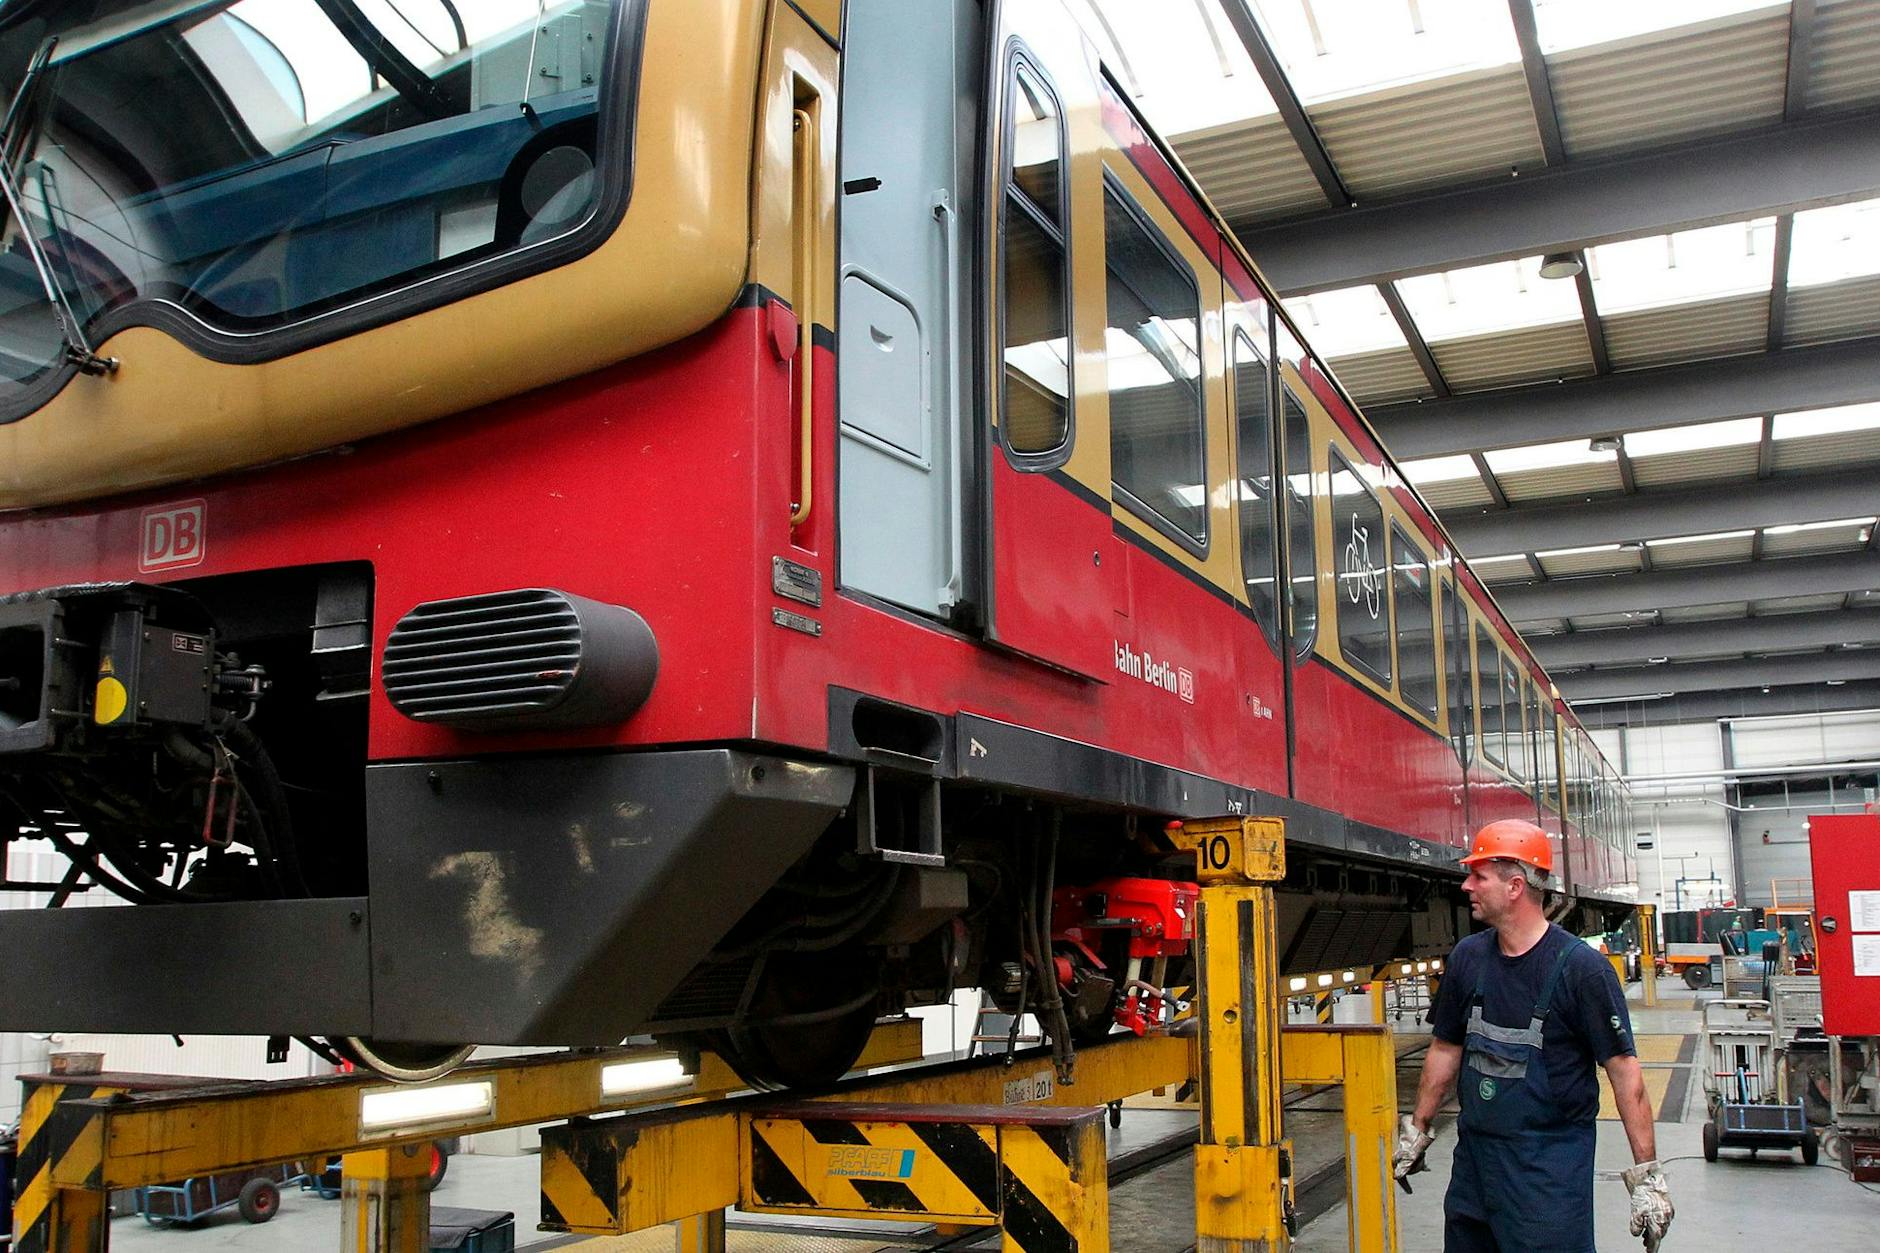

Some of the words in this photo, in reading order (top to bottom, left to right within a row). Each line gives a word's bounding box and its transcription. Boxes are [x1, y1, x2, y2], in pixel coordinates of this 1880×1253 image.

[147, 510, 198, 561] DB
[1144, 651, 1177, 695] Berlin
[1197, 835, 1231, 870] 10
[1036, 1080, 1047, 1099] 20
[828, 1146, 892, 1169] PFAFF
